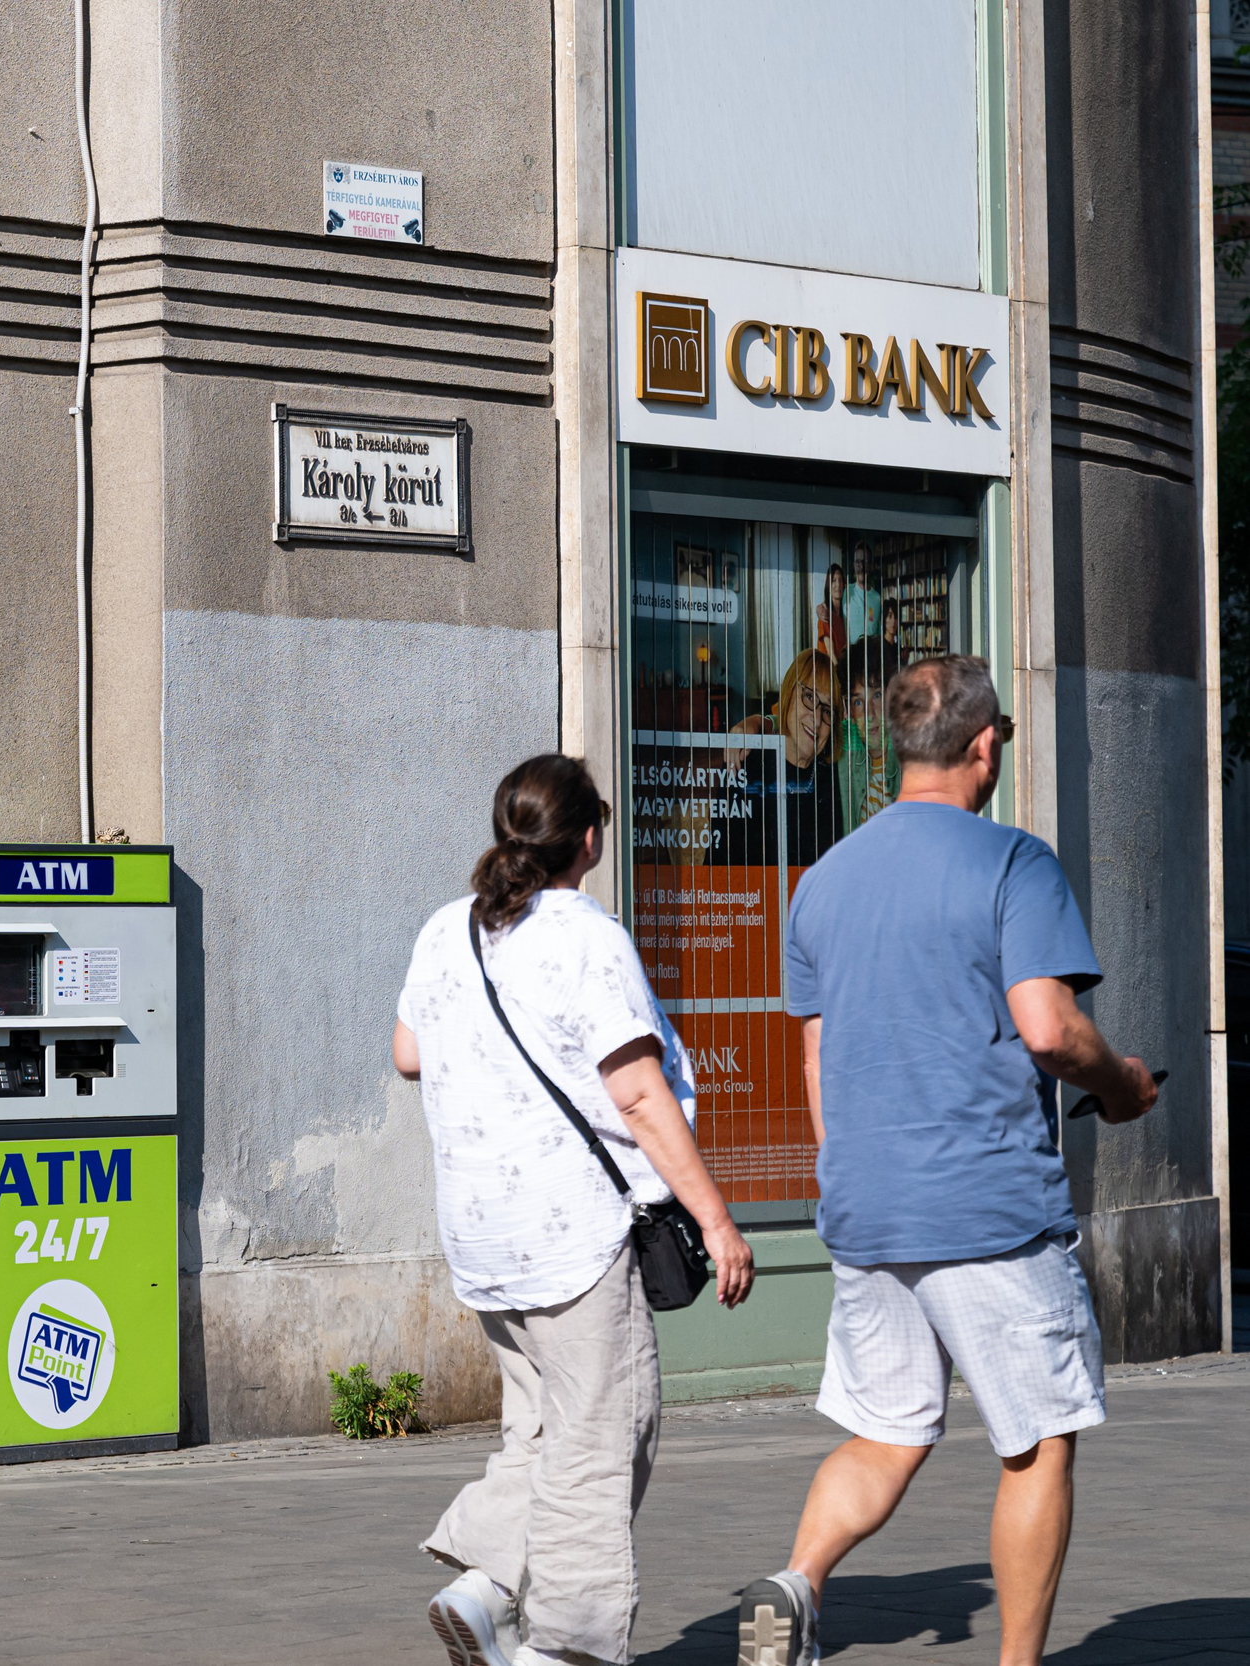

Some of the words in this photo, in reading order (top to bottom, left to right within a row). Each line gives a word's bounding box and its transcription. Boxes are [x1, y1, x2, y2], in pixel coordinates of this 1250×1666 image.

[353, 170, 419, 187] ERZSÉBETVÁROS
[326, 189, 374, 206] TÉRFIGYELŐ
[375, 197, 421, 211] KAMERÁVAL
[348, 209, 400, 225] MEGFIGYELT
[352, 225, 396, 240] TERÜLET!!!
[726, 320, 830, 401] CIB
[840, 332, 996, 419] BANK
[355, 433, 430, 456] Erzsébetváros
[301, 456, 376, 514] Károly
[383, 462, 444, 508] körút
[674, 598, 708, 610] sikeres
[711, 600, 732, 613] volt!
[632, 760, 748, 788] ELSŐKÁRTYÁS
[633, 797, 675, 817] VAGY
[678, 793, 753, 819] VETERÁN
[633, 823, 721, 849] BANKOLÓ?
[16, 861, 89, 890] ATM
[667, 888, 695, 904] Családi
[697, 889, 761, 908] Flottacsomaggal
[735, 911, 764, 926] minden
[686, 1047, 742, 1074] BANK
[723, 1080, 754, 1096] Group
[14, 1216, 110, 1264] 24/7
[32, 1323, 91, 1360] ATM
[28, 1344, 86, 1382] Point
